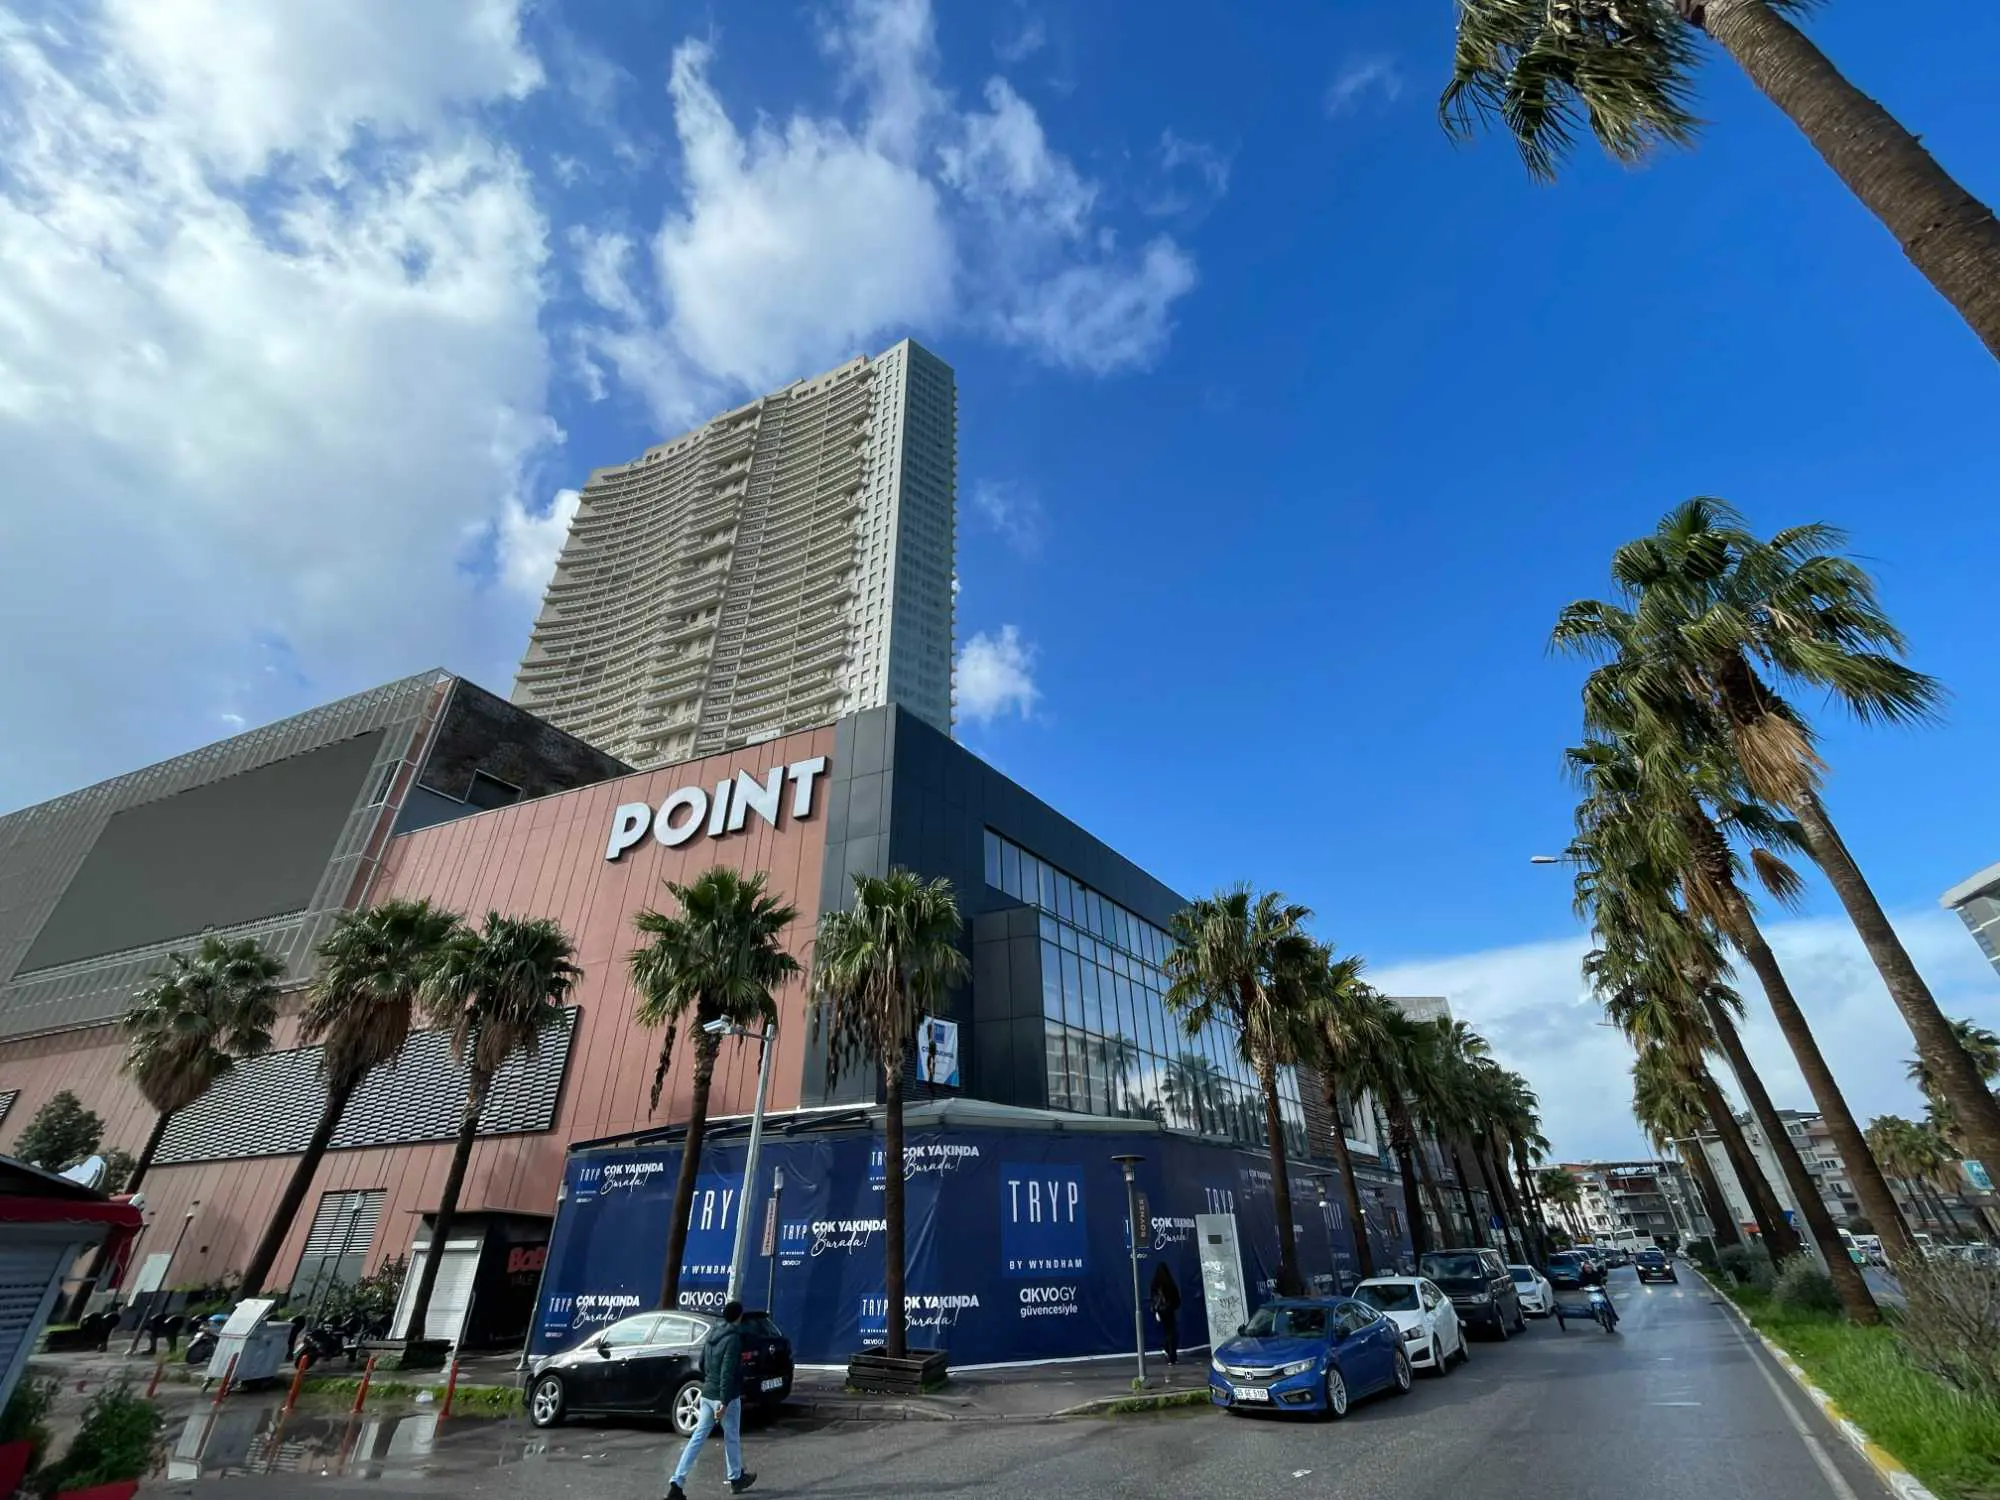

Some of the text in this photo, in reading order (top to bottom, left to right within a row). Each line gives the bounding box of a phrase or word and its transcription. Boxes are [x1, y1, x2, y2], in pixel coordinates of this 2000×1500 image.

[605, 756, 830, 861] POINT
[927, 1145, 979, 1157] YAKINDA
[624, 1162, 664, 1174] YAKINDA
[1008, 1180, 1079, 1222] TRYP
[687, 1189, 737, 1231] TRY
[783, 1224, 807, 1240] TRYP
[812, 1219, 887, 1234] ÇOK YAKINDA
[1009, 1258, 1083, 1270] BY WYNDHAM
[598, 1295, 640, 1307] YAKINDA
[863, 1299, 889, 1317] TRYP
[923, 1295, 979, 1308] YAKINDA
[1020, 1303, 1078, 1318] güvencesiyle
